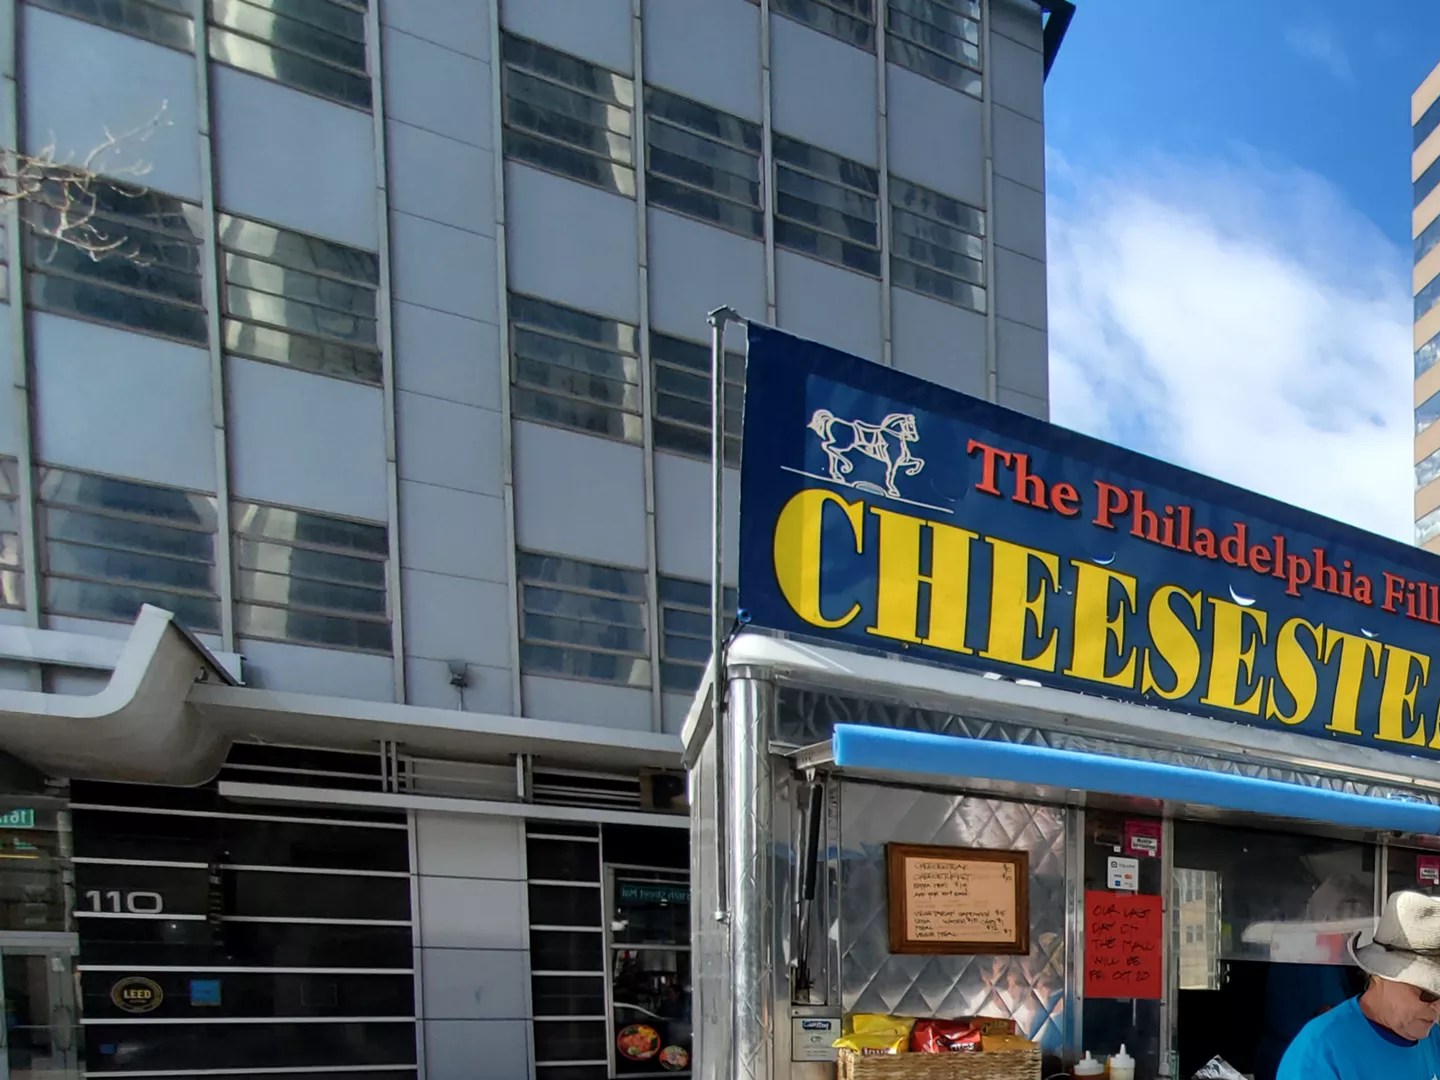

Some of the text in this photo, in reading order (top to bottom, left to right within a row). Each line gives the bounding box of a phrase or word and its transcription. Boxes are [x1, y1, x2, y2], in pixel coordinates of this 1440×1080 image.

[967, 438, 1080, 517] The
[1092, 480, 1373, 605] Philadelphia
[86, 890, 164, 914] 110
[1091, 938, 1117, 950] THE
[123, 989, 151, 1000] LEED
